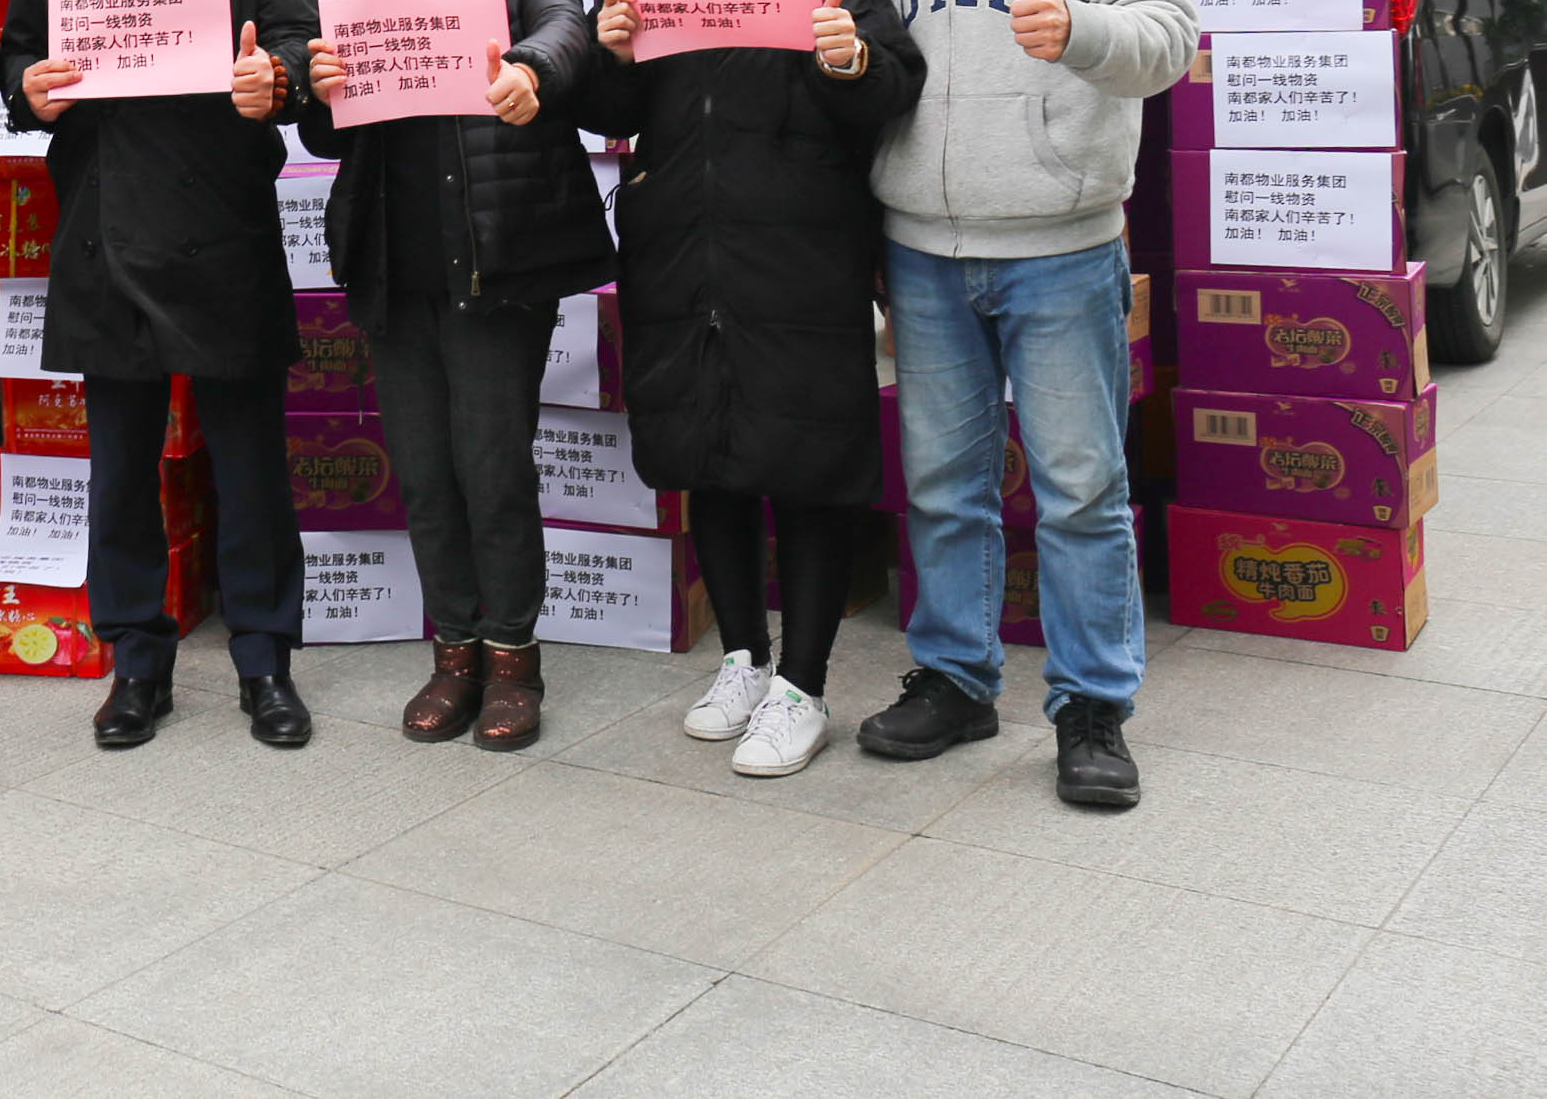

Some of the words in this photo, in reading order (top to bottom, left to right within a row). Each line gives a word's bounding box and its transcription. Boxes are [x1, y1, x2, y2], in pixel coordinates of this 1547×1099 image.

[640, 2, 780, 15] 南都家人们辛苦了！
[61, 13, 153, 31] 慰问一线物资
[334, 16, 460, 39] 南都物业服务集团
[644, 17, 683, 32] 加油！
[701, 17, 741, 28] 加油！
[61, 30, 193, 53] 南都家人们辛苦了！
[337, 37, 431, 58] 慰问一线物资
[117, 54, 155, 69] 加油！
[1227, 55, 1348, 69] 南都物业服务集团
[342, 79, 381, 99] 加油！
[398, 75, 436, 90] 加油！
[1227, 73, 1317, 87] 慰问一线物资
[1228, 91, 1356, 105] 南都家人们辛苦了！
[1229, 109, 1264, 122] 加油！
[1282, 109, 1318, 122] 加油！
[1225, 172, 1346, 188] 南都物业服务集团
[1224, 190, 1315, 206] 慰问一线物资
[1225, 208, 1353, 225] 南都家人们辛苦了！
[1225, 226, 1261, 239] 加油！
[1278, 228, 1315, 243] 加油！
[1273, 327, 1342, 346] 老坛酸菜
[1269, 451, 1339, 470] 老坛酸菜
[12, 492, 85, 509] 慰问一线物资
[6, 526, 36, 537] 加油！
[48, 529, 79, 540] 加油！
[1234, 557, 1332, 585] 精炖番茄
[1257, 581, 1318, 602] 牛肉面
[570, 605, 604, 621] 加油！
